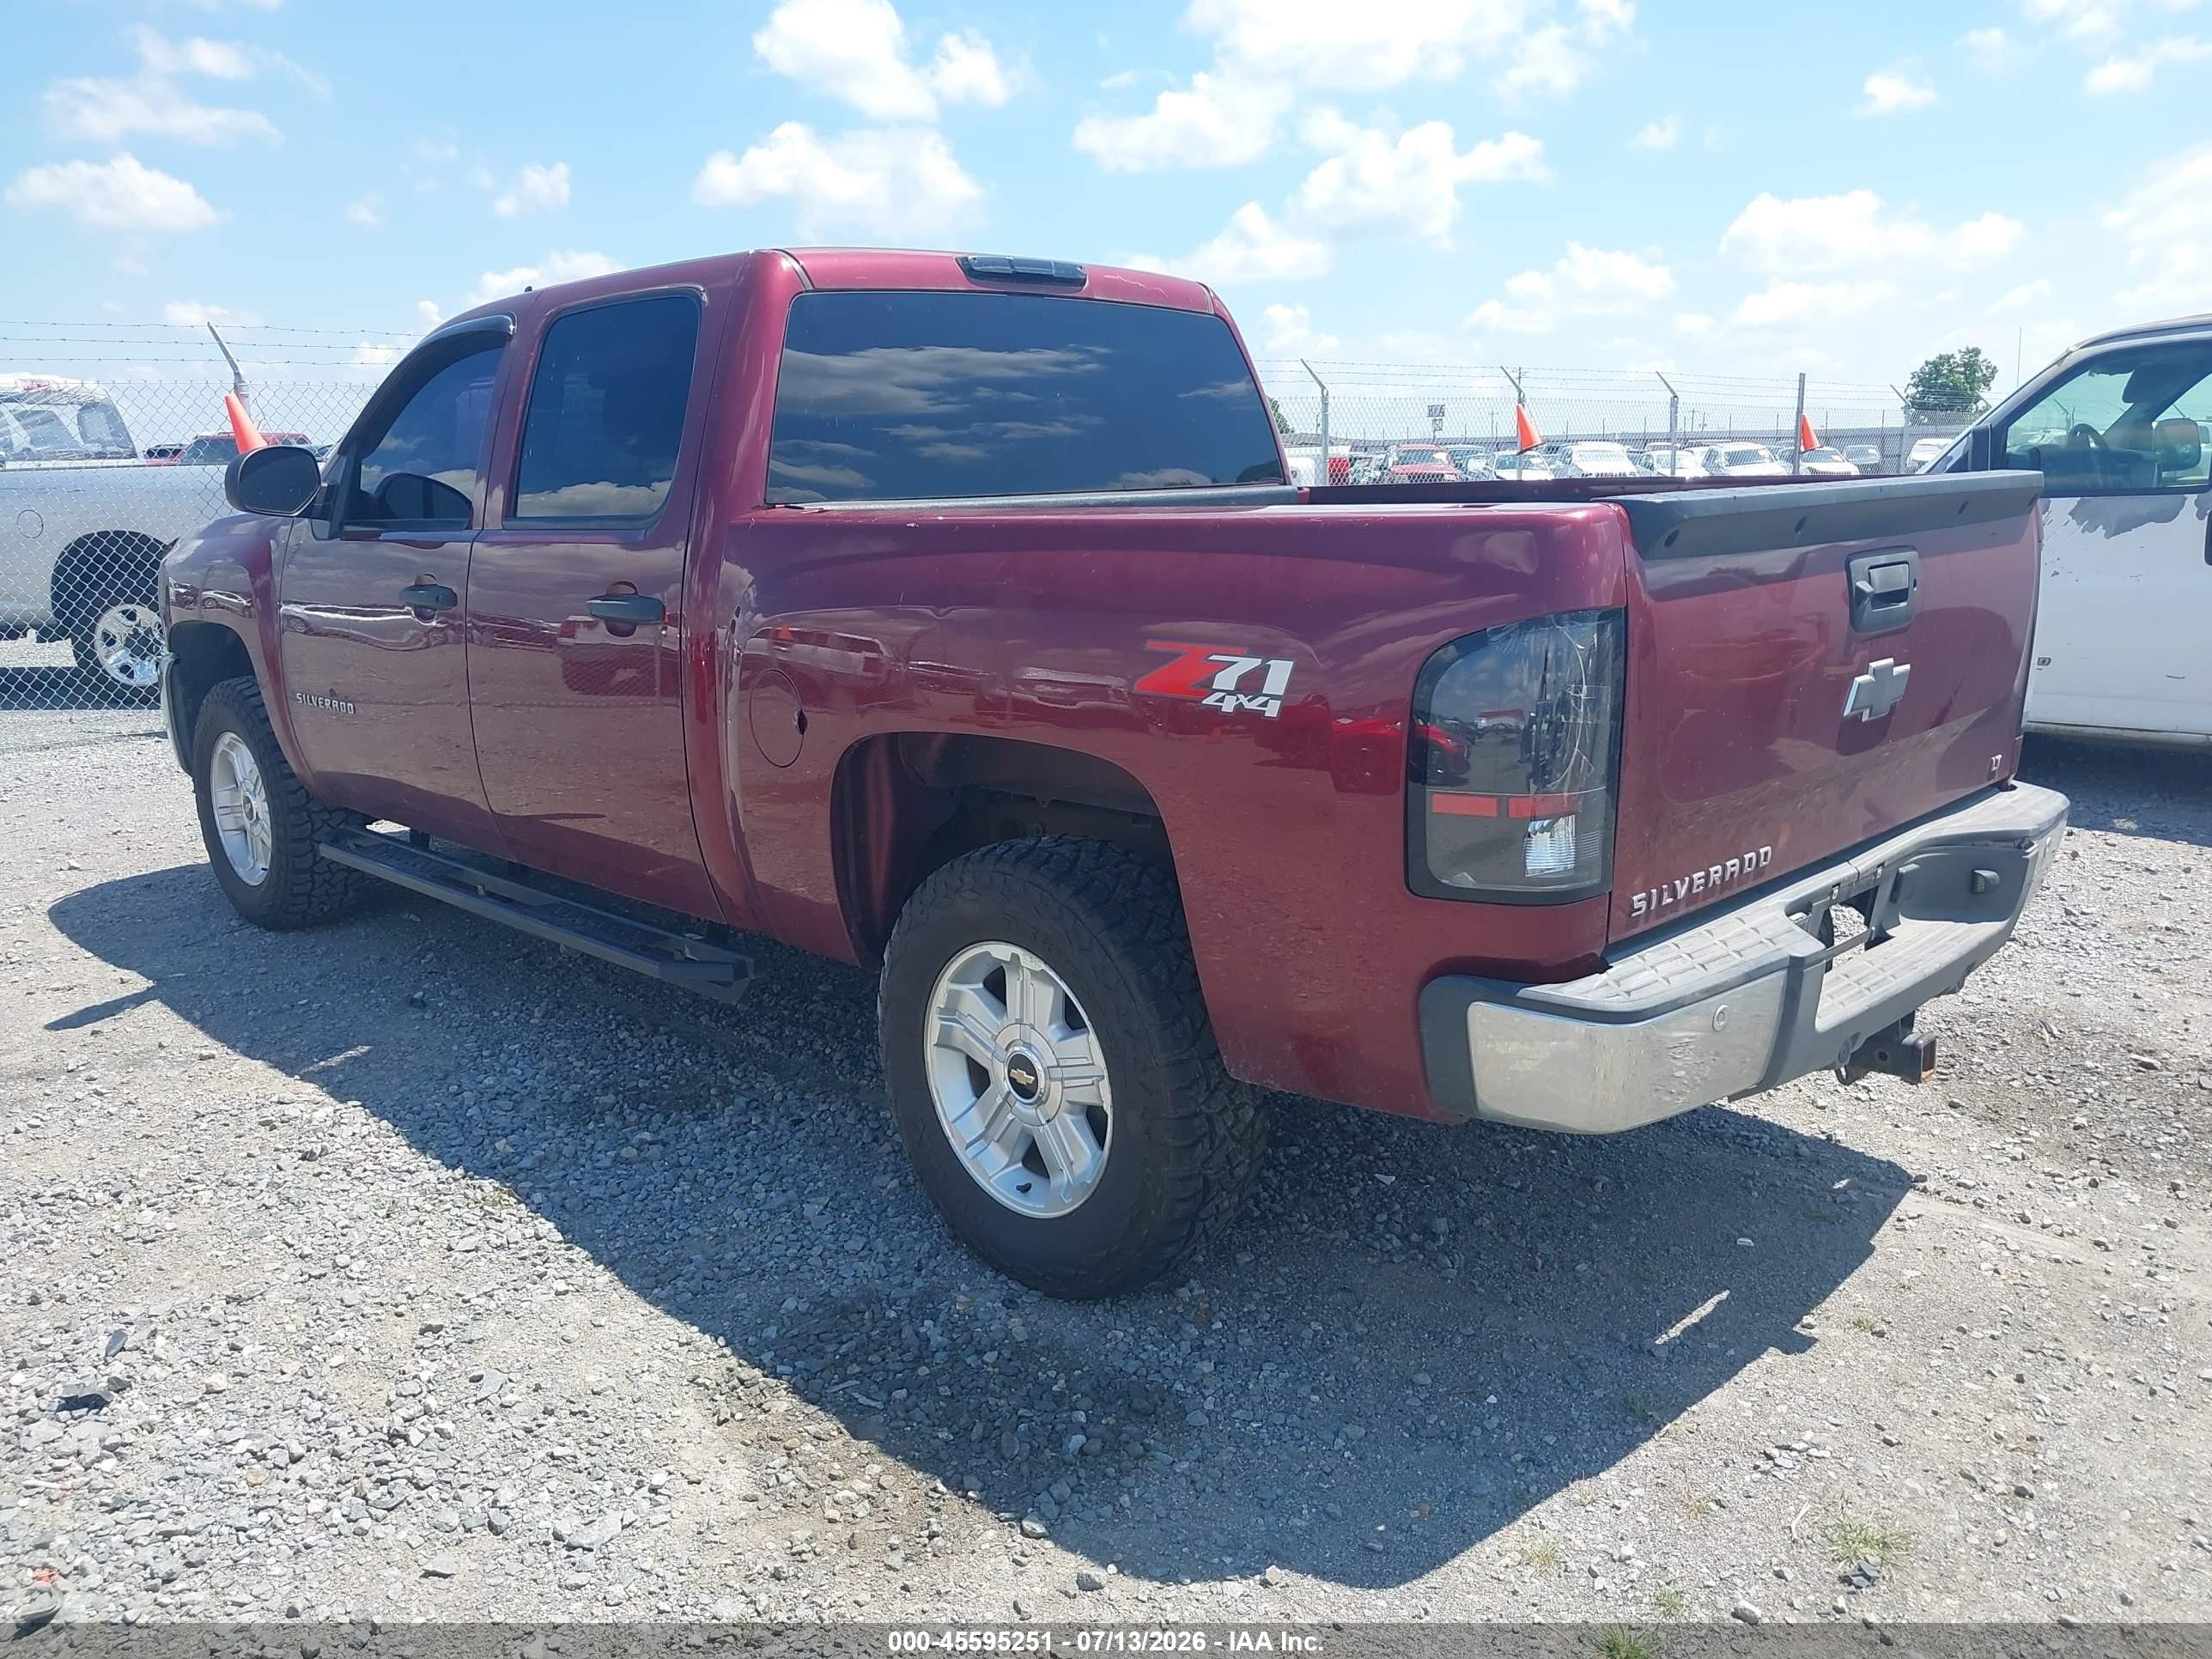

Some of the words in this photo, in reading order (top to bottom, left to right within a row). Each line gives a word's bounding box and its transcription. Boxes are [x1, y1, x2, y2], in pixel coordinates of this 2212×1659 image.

[1133, 641, 1295, 699] Z71
[295, 692, 356, 714] SILVERADO
[1990, 753, 2002, 772] LT
[1631, 845, 1772, 918] SILVERADO
